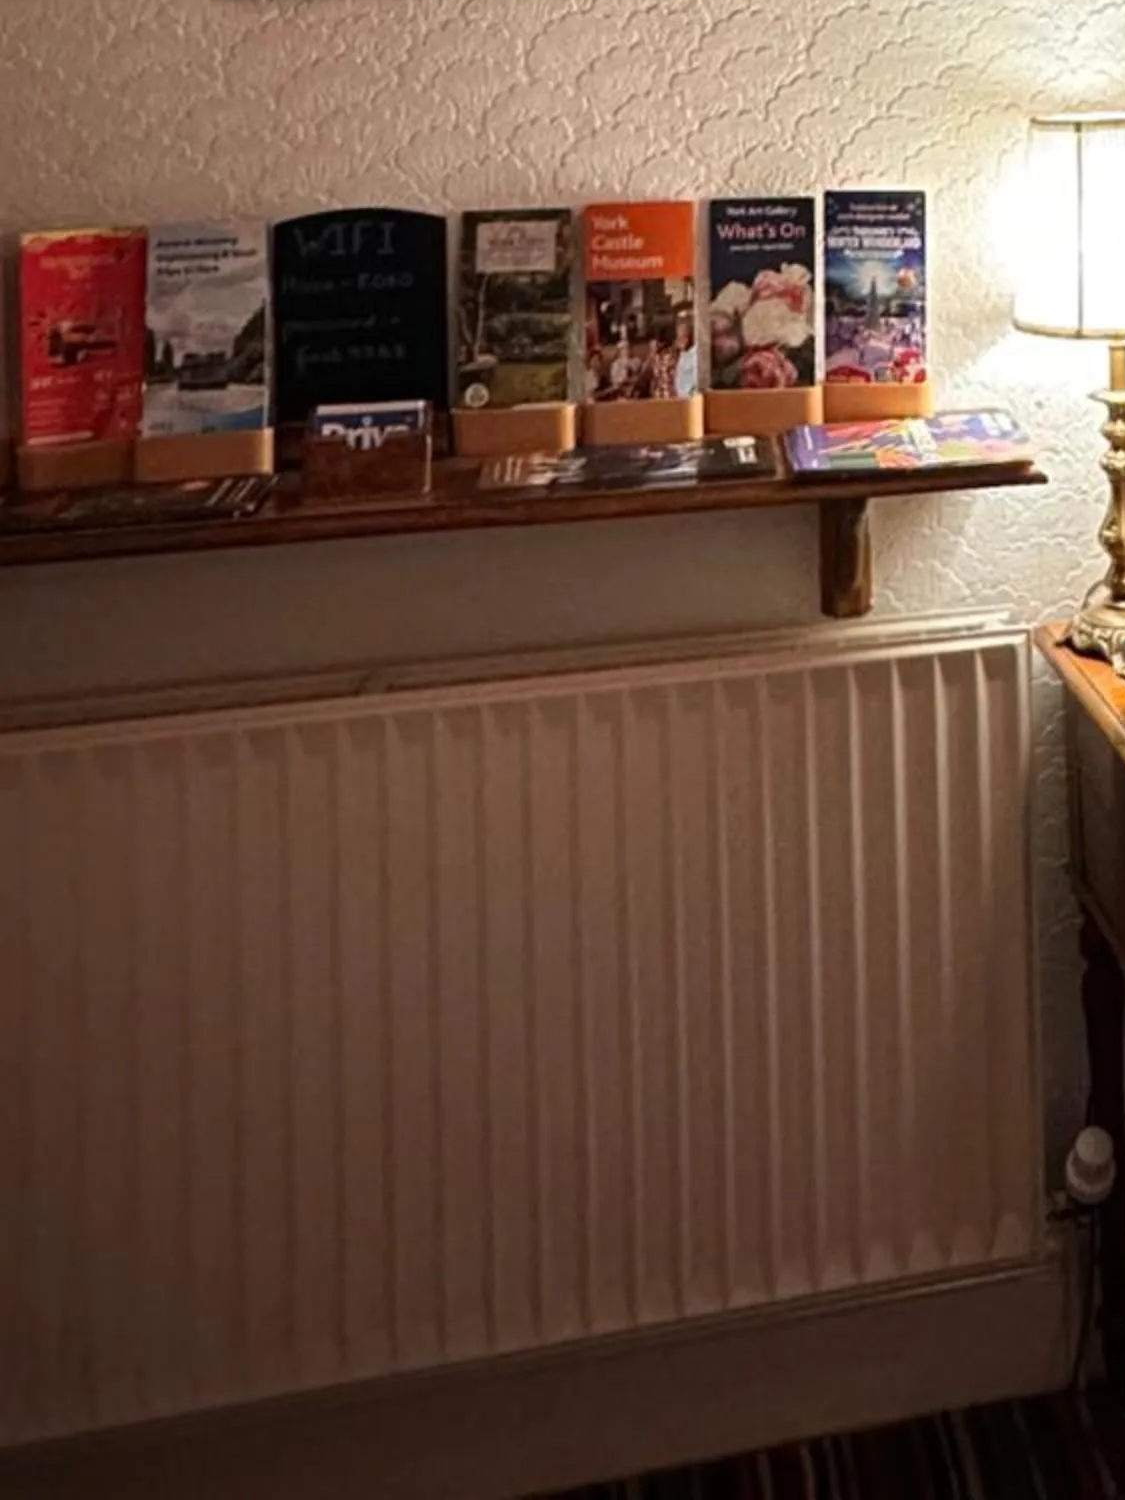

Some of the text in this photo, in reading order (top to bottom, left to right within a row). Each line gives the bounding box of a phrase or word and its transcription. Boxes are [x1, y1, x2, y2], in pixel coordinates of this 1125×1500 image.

[591, 213, 629, 230] York
[716, 221, 806, 239] What's On
[591, 233, 645, 250] Castle
[591, 252, 664, 270] Museum
